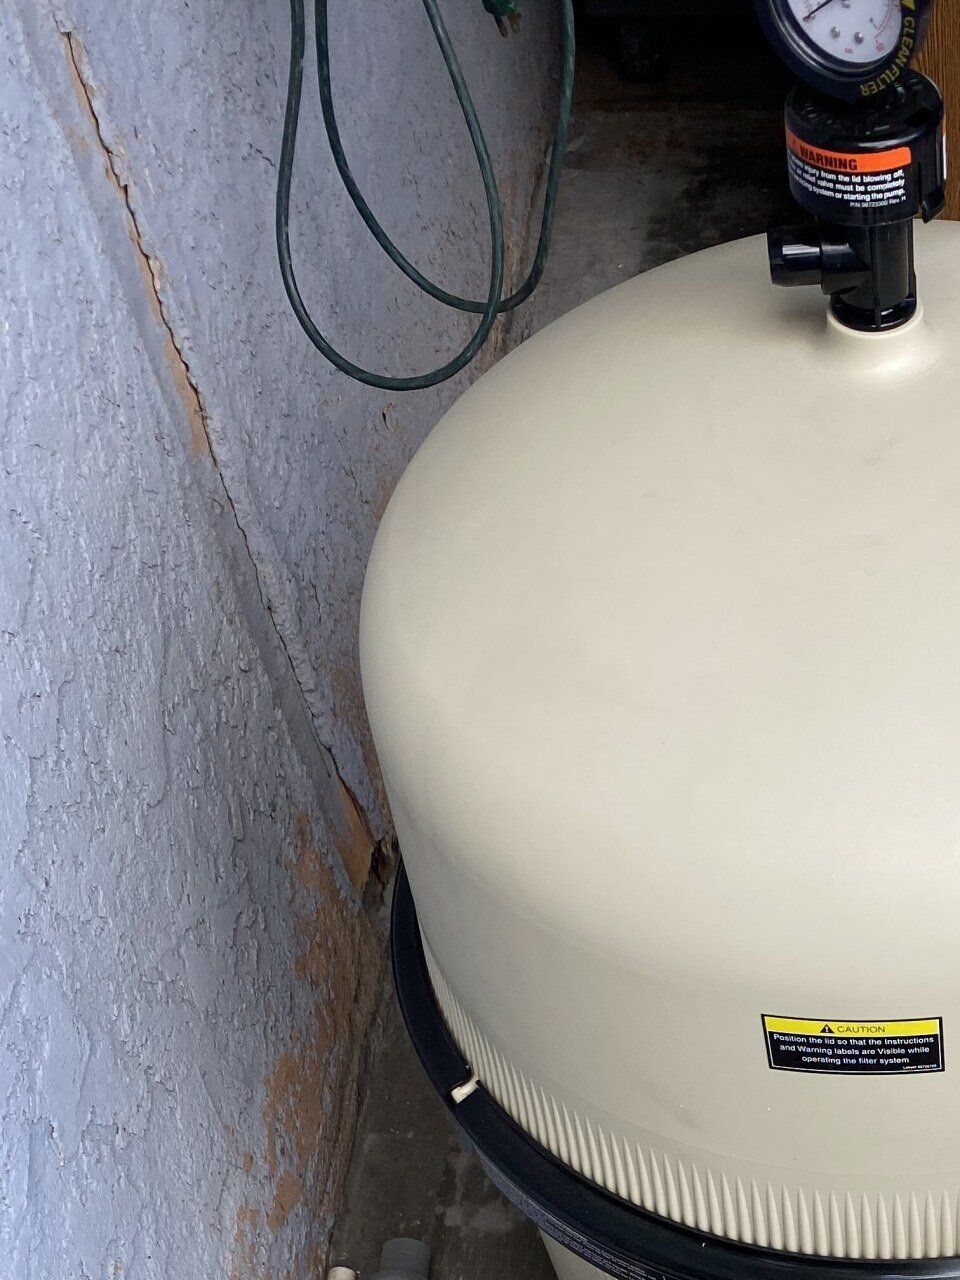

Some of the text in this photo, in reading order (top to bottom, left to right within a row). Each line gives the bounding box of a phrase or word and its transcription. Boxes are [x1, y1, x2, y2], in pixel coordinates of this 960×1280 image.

[860, 17, 915, 96] CLEAN FILTER
[800, 147, 858, 171] WARNING
[821, 171, 836, 180] from
[838, 174, 850, 182] the
[863, 173, 891, 183] blowing
[817, 180, 834, 188] valve
[835, 183, 853, 191] must
[867, 179, 905, 191] completely
[835, 190, 842, 198] or
[843, 193, 870, 201] starting
[871, 192, 883, 200] the
[884, 188, 905, 199] pump.
[773, 1034, 807, 1043] Position
[885, 1037, 934, 1045] Instructions
[797, 1046, 832, 1055] Warning
[802, 1056, 841, 1065] operating
